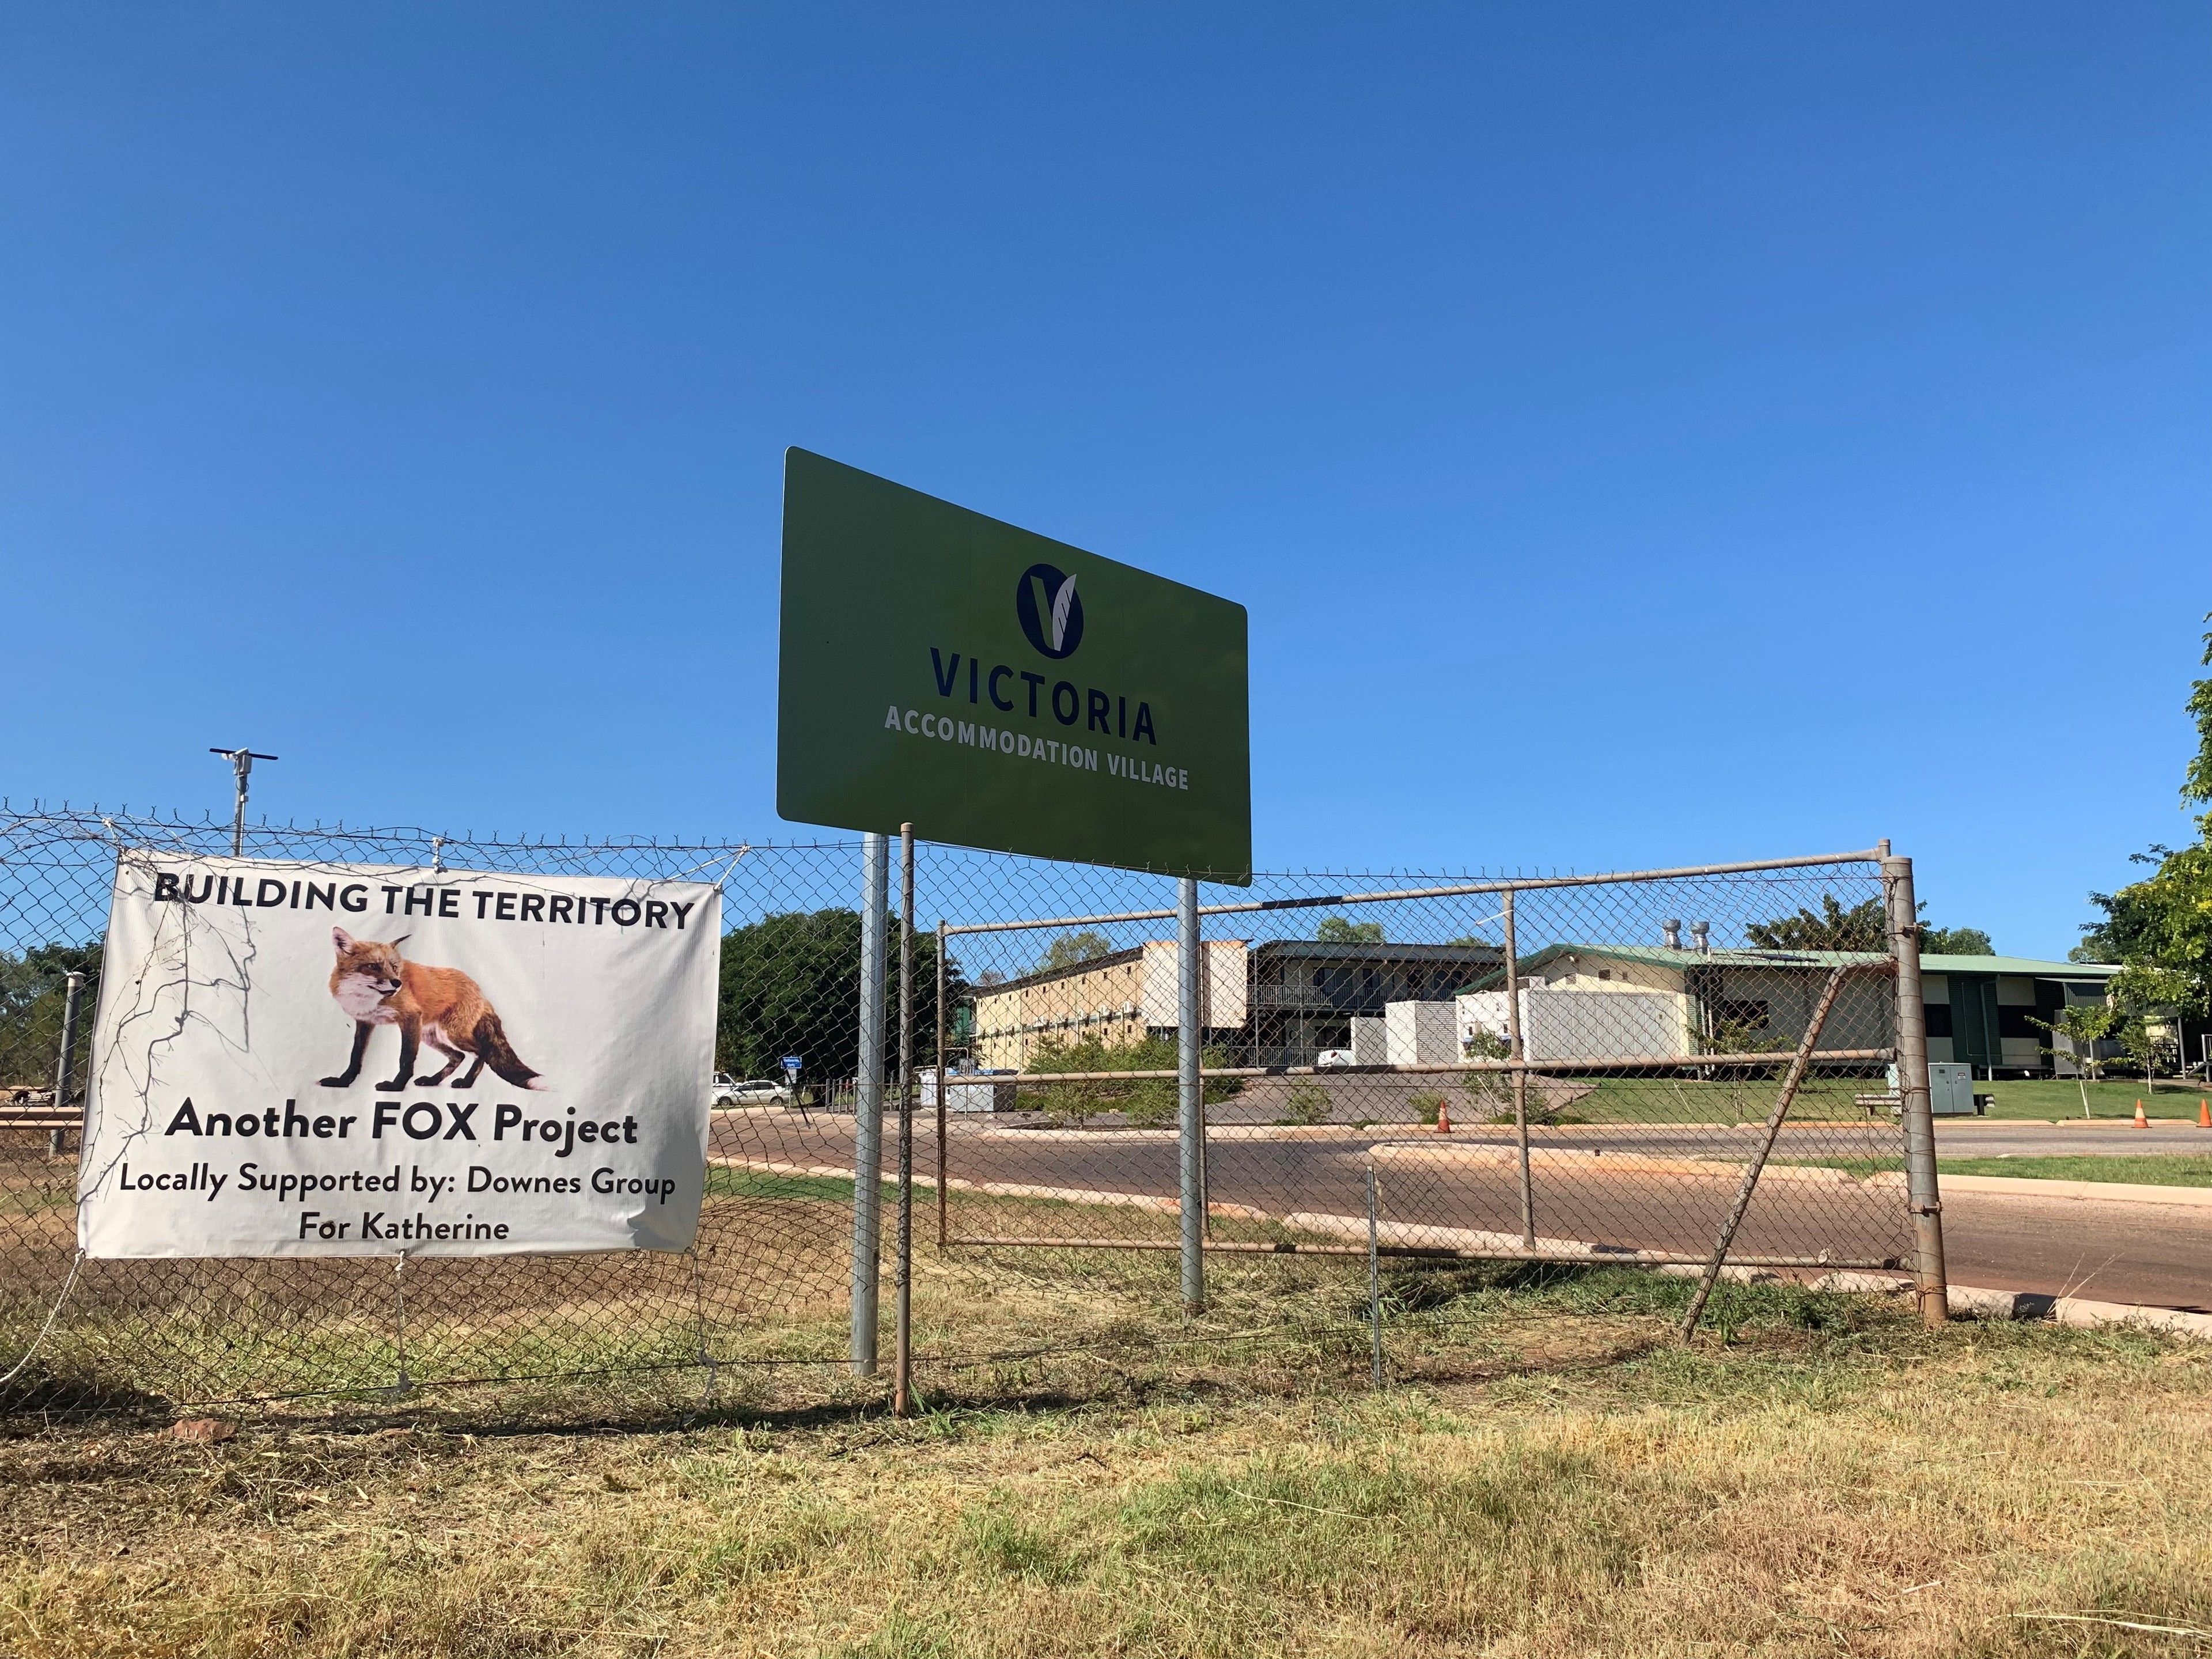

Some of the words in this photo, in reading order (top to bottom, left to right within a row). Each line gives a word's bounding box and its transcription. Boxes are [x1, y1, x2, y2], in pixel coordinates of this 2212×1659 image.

[930, 647, 1157, 747] VICTORIA
[884, 705, 1097, 771] ACCOMMODATION
[1107, 753, 1188, 790] VILLAGE
[154, 873, 369, 912] BUILDING
[381, 885, 461, 918] THE
[473, 891, 695, 930] TERRITORY
[165, 1097, 358, 1138] Another
[372, 1101, 479, 1141] FOX
[494, 1104, 638, 1158] Project
[120, 1162, 228, 1202] Locally
[237, 1162, 400, 1202] Supported
[411, 1165, 454, 1203] by:
[467, 1166, 581, 1194] Downes
[591, 1167, 676, 1205] Group
[299, 1211, 351, 1240] For
[361, 1211, 509, 1240] Katherine
